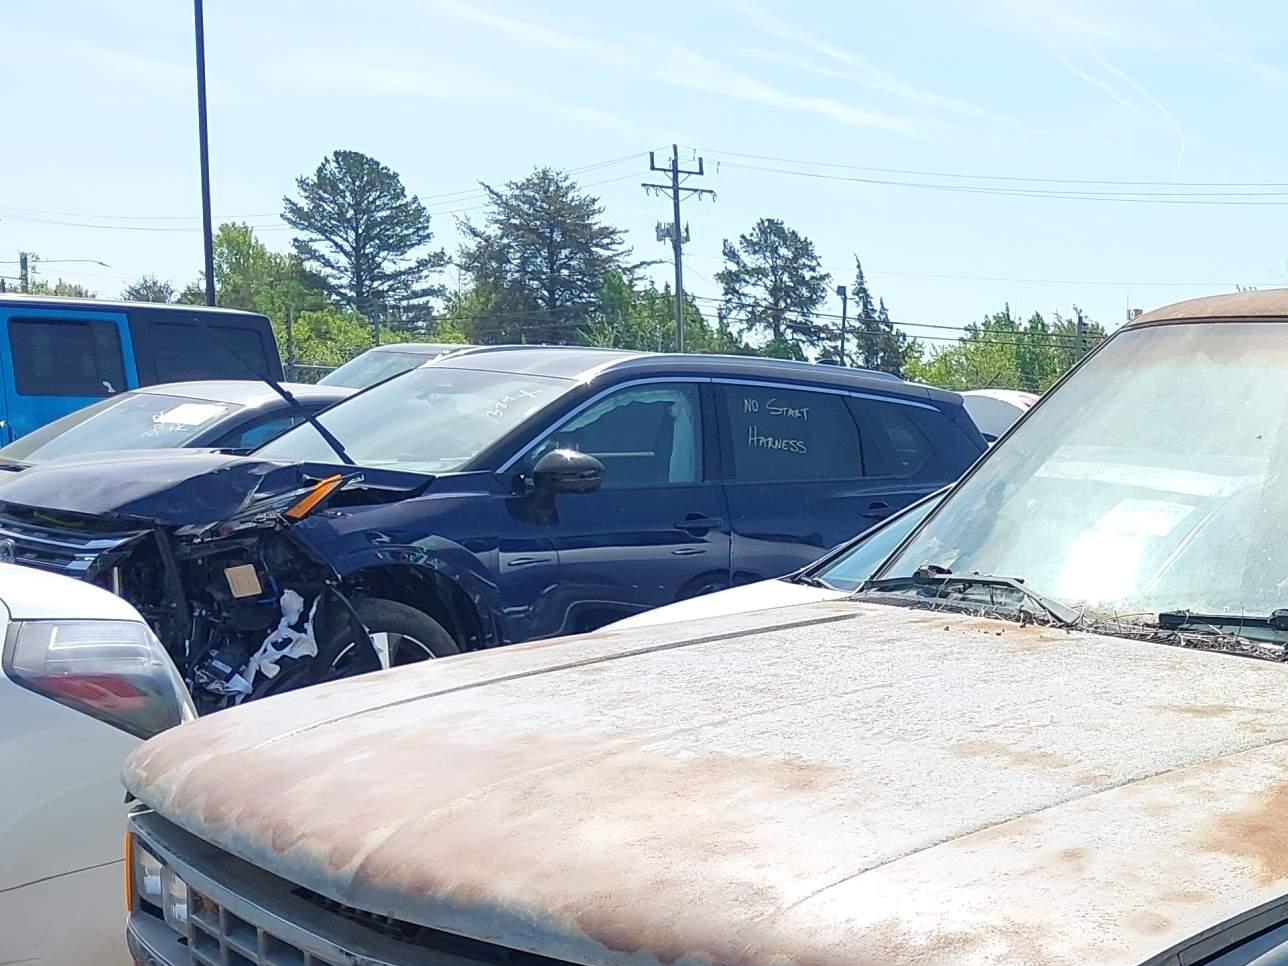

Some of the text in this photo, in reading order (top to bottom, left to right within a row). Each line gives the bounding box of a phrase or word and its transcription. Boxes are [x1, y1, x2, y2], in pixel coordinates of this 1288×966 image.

[744, 398, 810, 422] NO START
[748, 426, 808, 454] HARNESS
